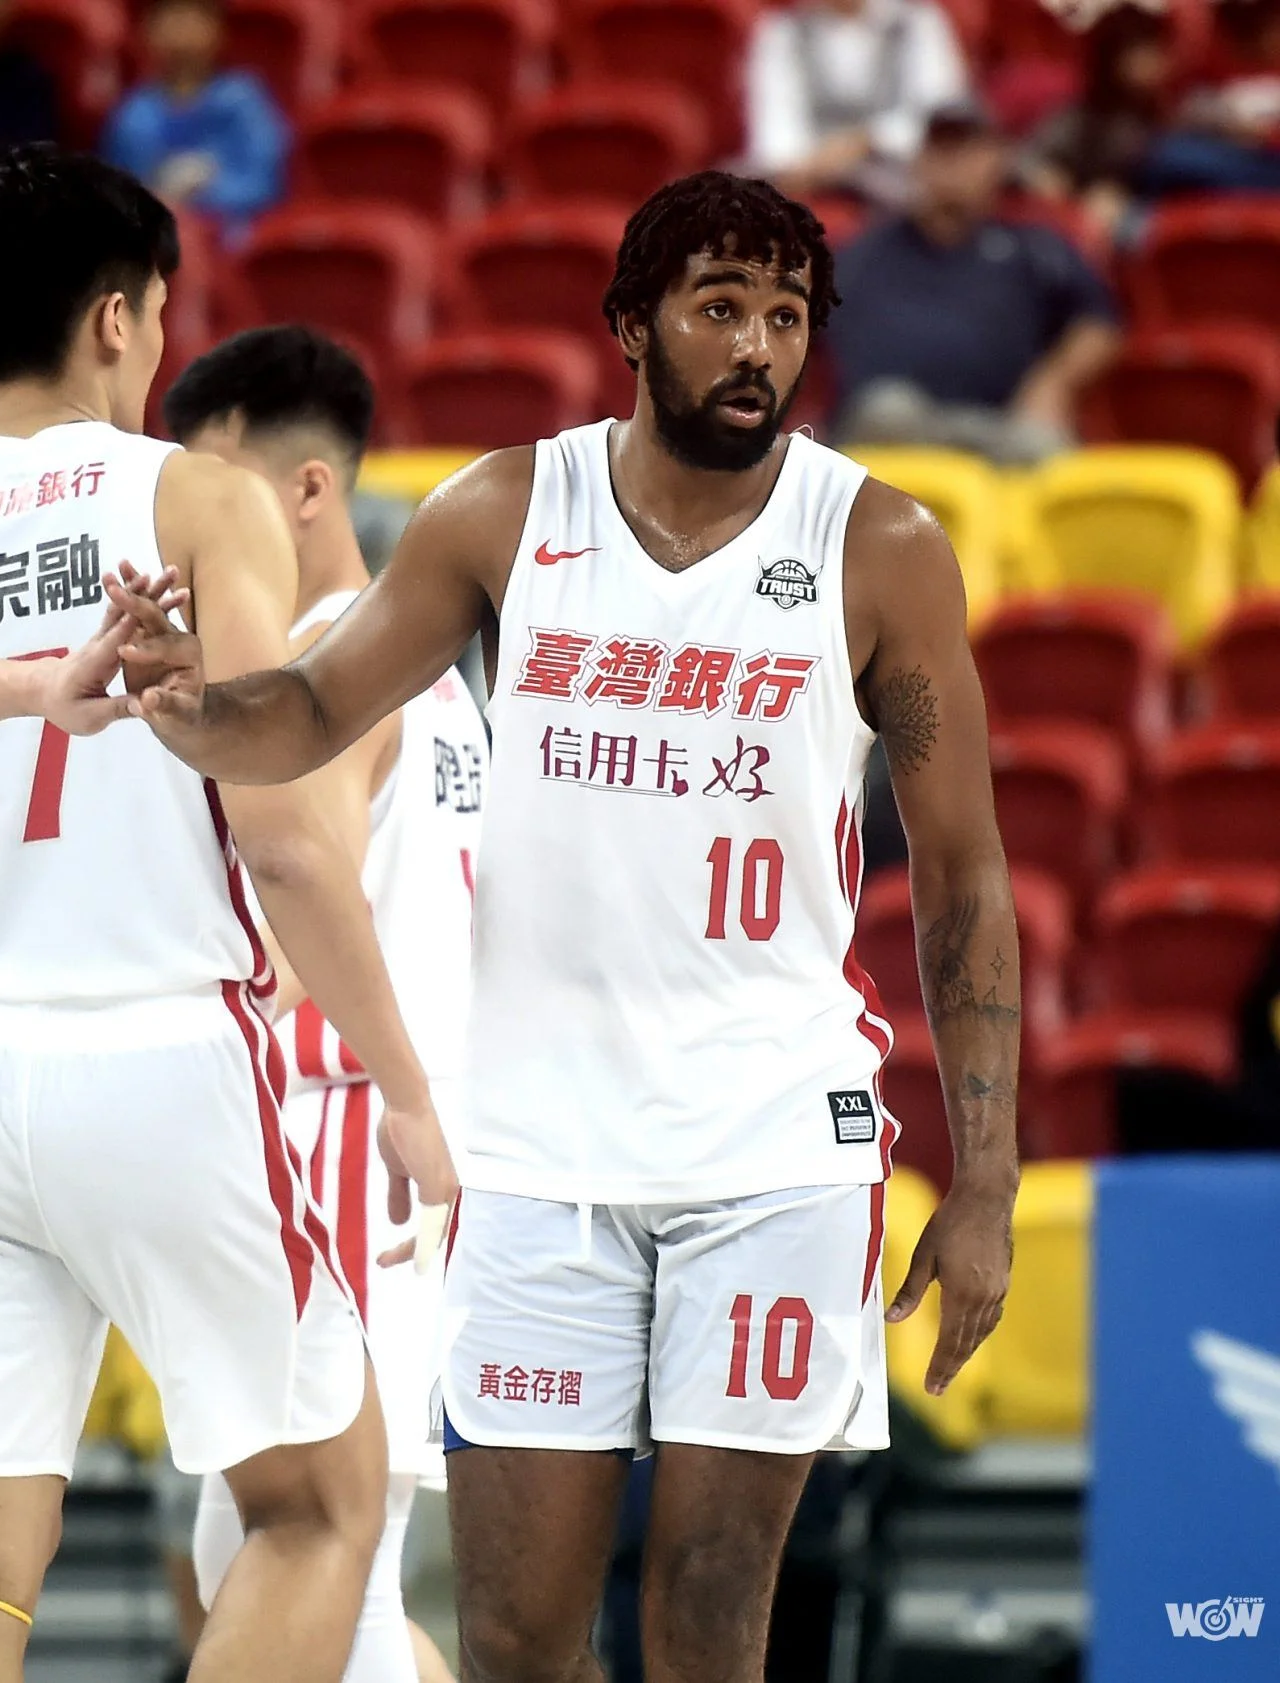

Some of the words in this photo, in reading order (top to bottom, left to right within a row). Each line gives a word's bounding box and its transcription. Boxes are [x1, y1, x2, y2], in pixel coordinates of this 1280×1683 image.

[759, 578, 815, 601] TRUST
[517, 630, 816, 721] 臺灣銀行
[705, 837, 785, 942] 10
[835, 1095, 869, 1112] XXL
[725, 1294, 814, 1401] 10
[477, 1363, 583, 1406] 黃金存摺
